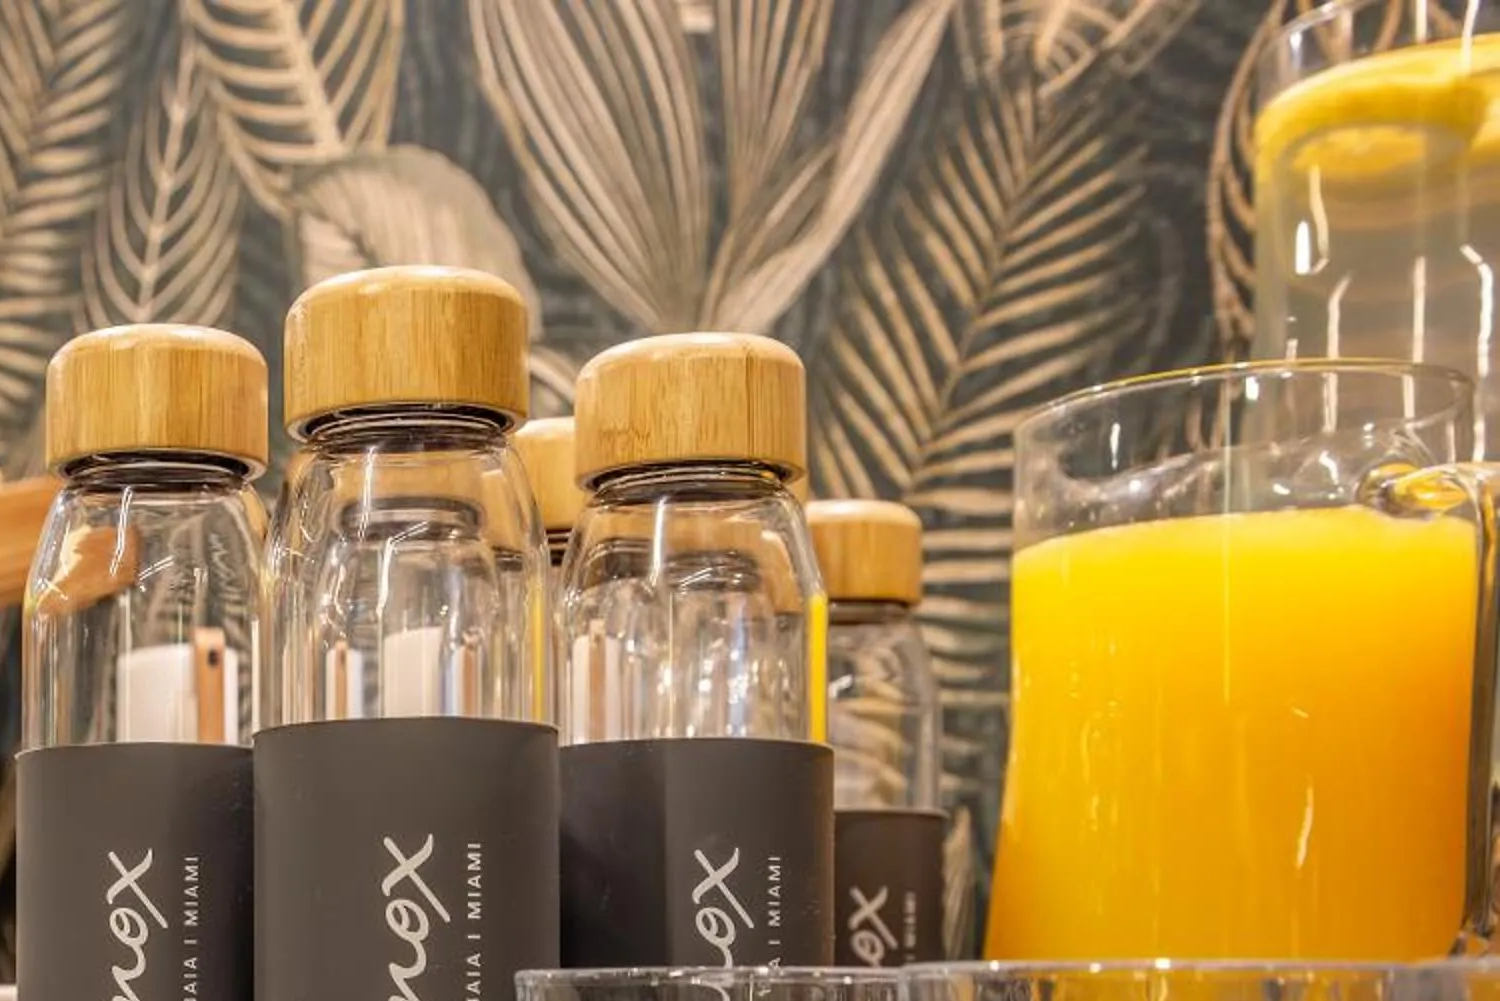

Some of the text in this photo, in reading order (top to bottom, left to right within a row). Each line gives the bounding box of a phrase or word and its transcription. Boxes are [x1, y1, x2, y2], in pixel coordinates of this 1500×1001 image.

[183, 856, 200, 927] MIAMI
[466, 842, 484, 920] MIAMI
[766, 855, 783, 928] MIAMI
